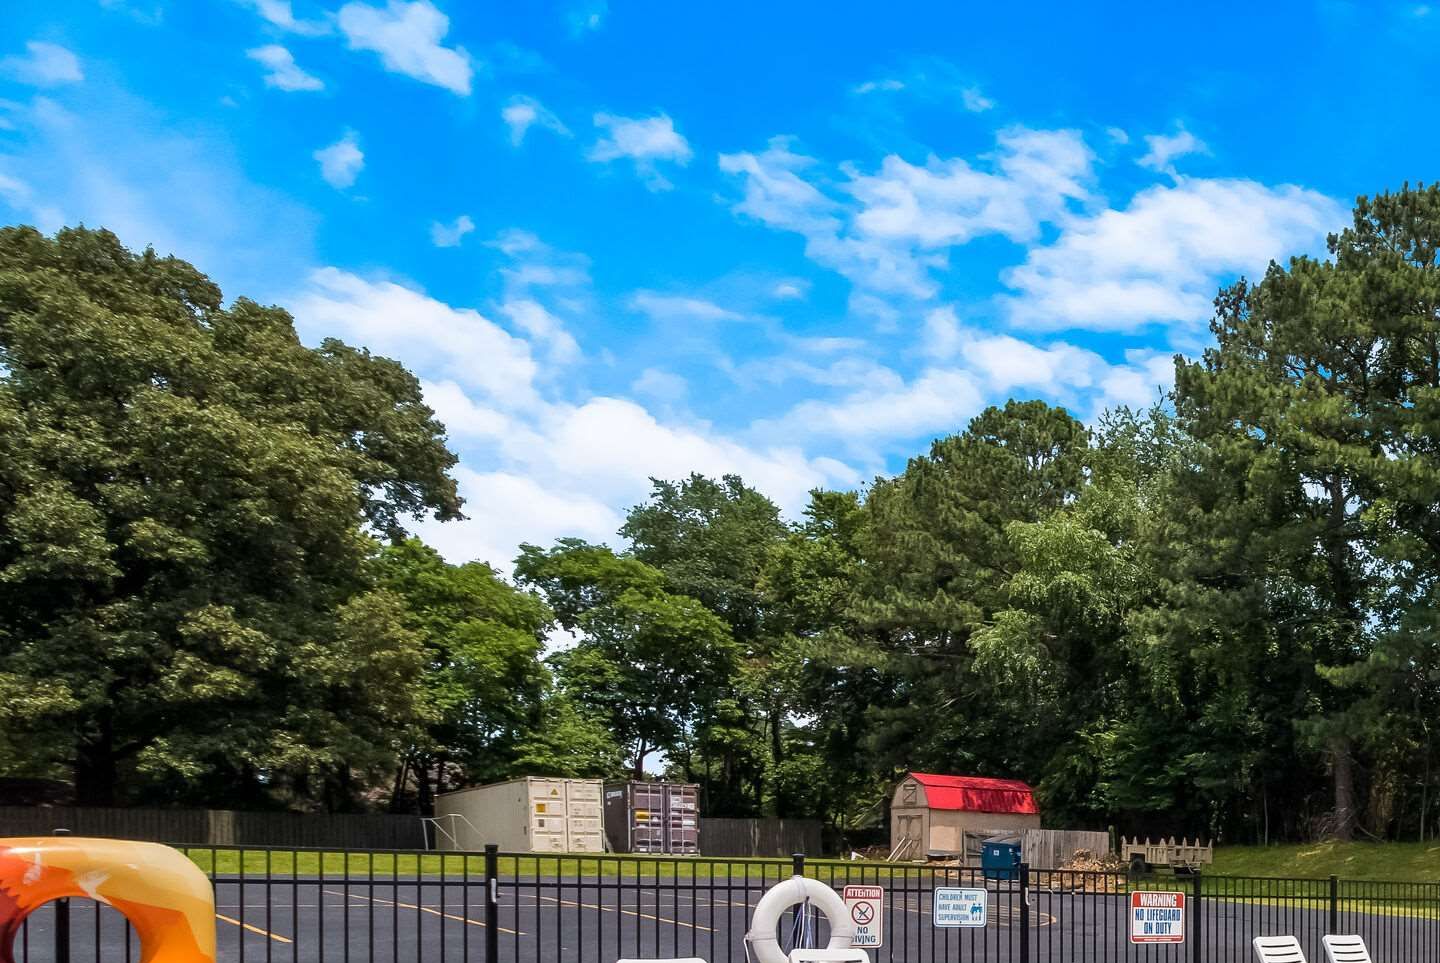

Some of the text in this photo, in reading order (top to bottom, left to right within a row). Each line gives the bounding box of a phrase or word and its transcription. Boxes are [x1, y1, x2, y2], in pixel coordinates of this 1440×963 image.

[847, 889, 880, 897] ATTENTION
[938, 893, 962, 901] CHILDREN
[1140, 893, 1177, 906] WARNING
[1135, 909, 1180, 921] NO LIFEGUARD
[857, 926, 868, 934] NO
[1144, 922, 1171, 934] ON DUTY
